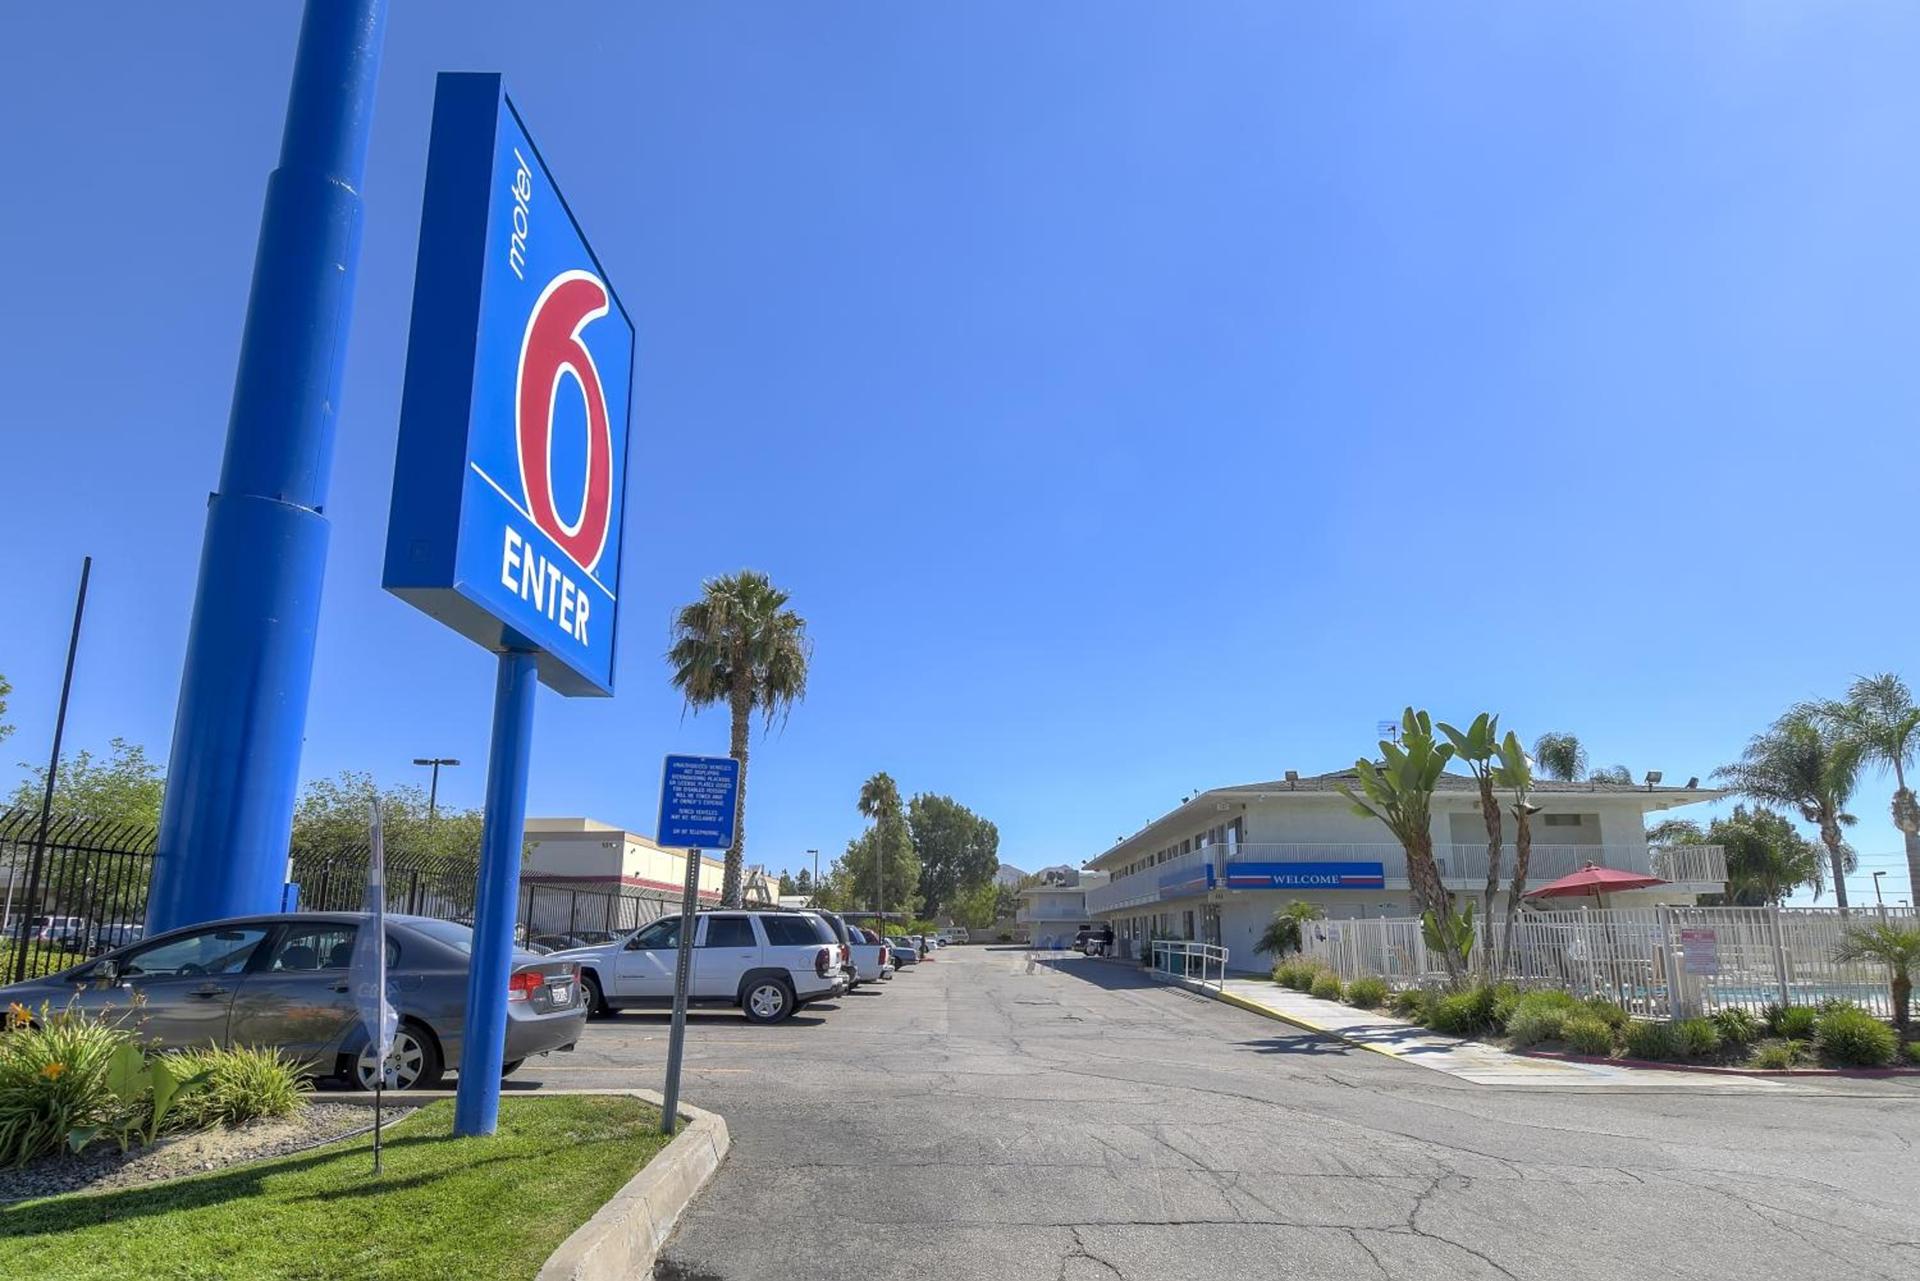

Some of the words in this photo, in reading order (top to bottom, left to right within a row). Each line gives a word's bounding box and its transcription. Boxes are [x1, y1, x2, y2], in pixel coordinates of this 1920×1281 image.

[509, 148, 532, 281] motel
[516, 268, 613, 575] 6
[501, 525, 590, 647] ENTER
[1273, 874, 1340, 884] WELCOME
